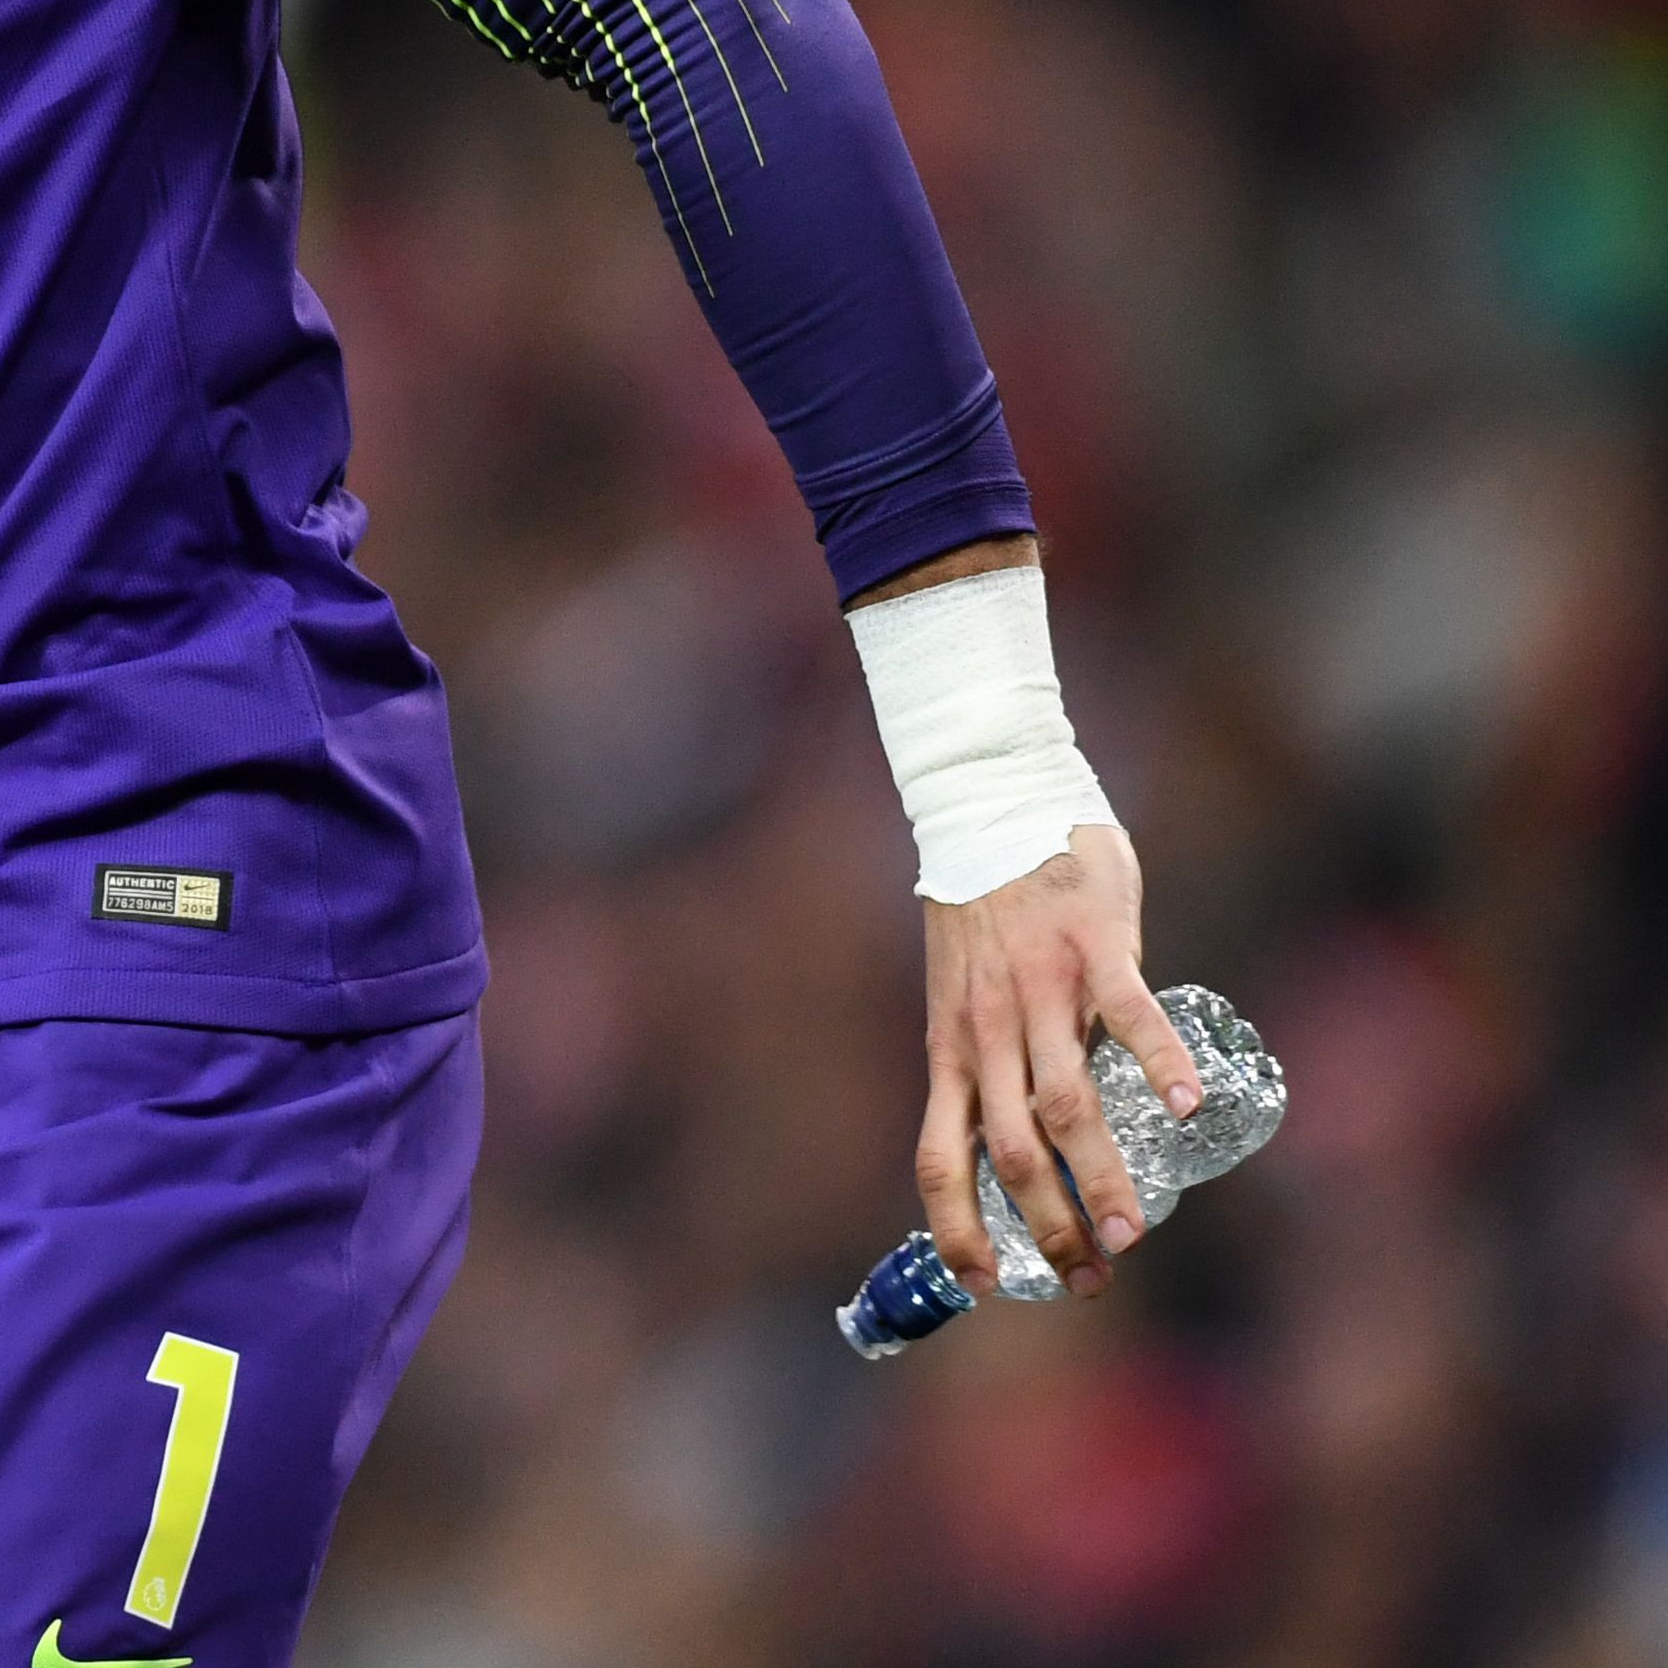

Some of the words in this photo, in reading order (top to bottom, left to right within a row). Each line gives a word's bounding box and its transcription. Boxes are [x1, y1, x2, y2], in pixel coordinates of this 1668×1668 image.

[109, 876, 175, 890] AUTHENTIC
[182, 903, 213, 915] 2018
[124, 1331, 240, 1630] 1
